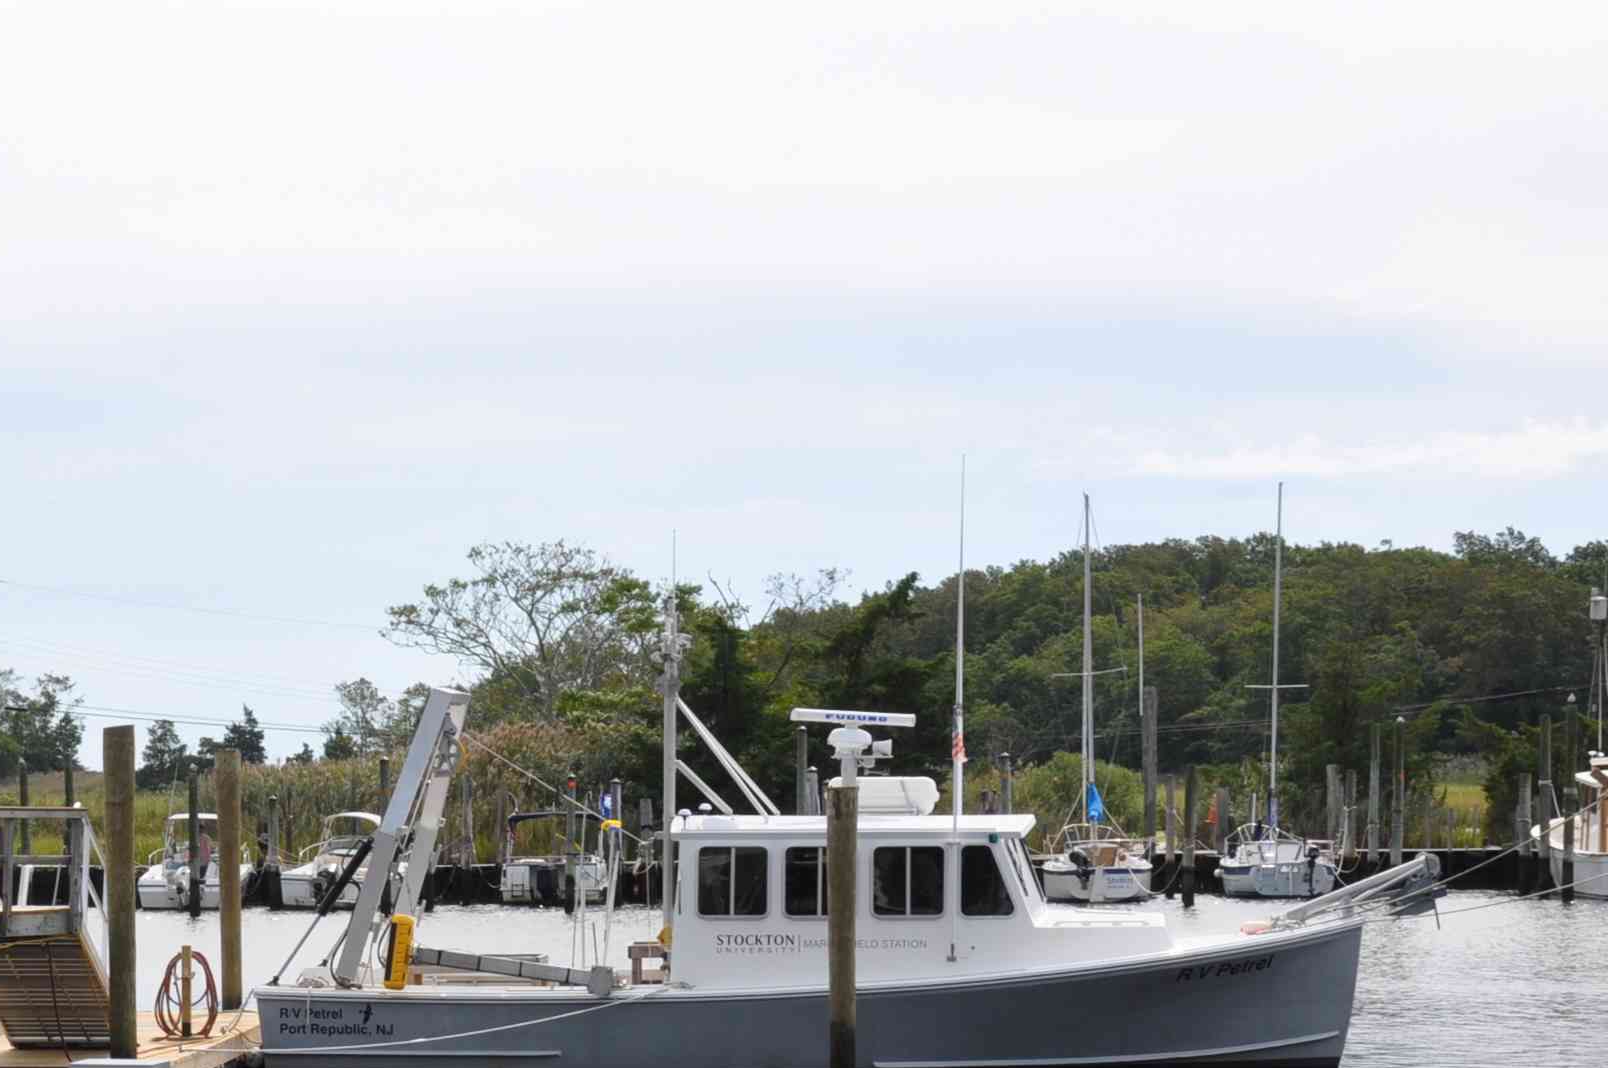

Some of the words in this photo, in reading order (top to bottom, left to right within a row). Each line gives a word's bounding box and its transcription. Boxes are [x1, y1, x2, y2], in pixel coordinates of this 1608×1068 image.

[716, 934, 795, 946] STOCKTON
[880, 939, 928, 949] STATION
[716, 946, 795, 954] UNIVERSITY
[305, 1008, 343, 1020] Petrel
[279, 1023, 307, 1034] Port
[311, 1023, 372, 1037] Republic,
[376, 1023, 394, 1035] NJ
